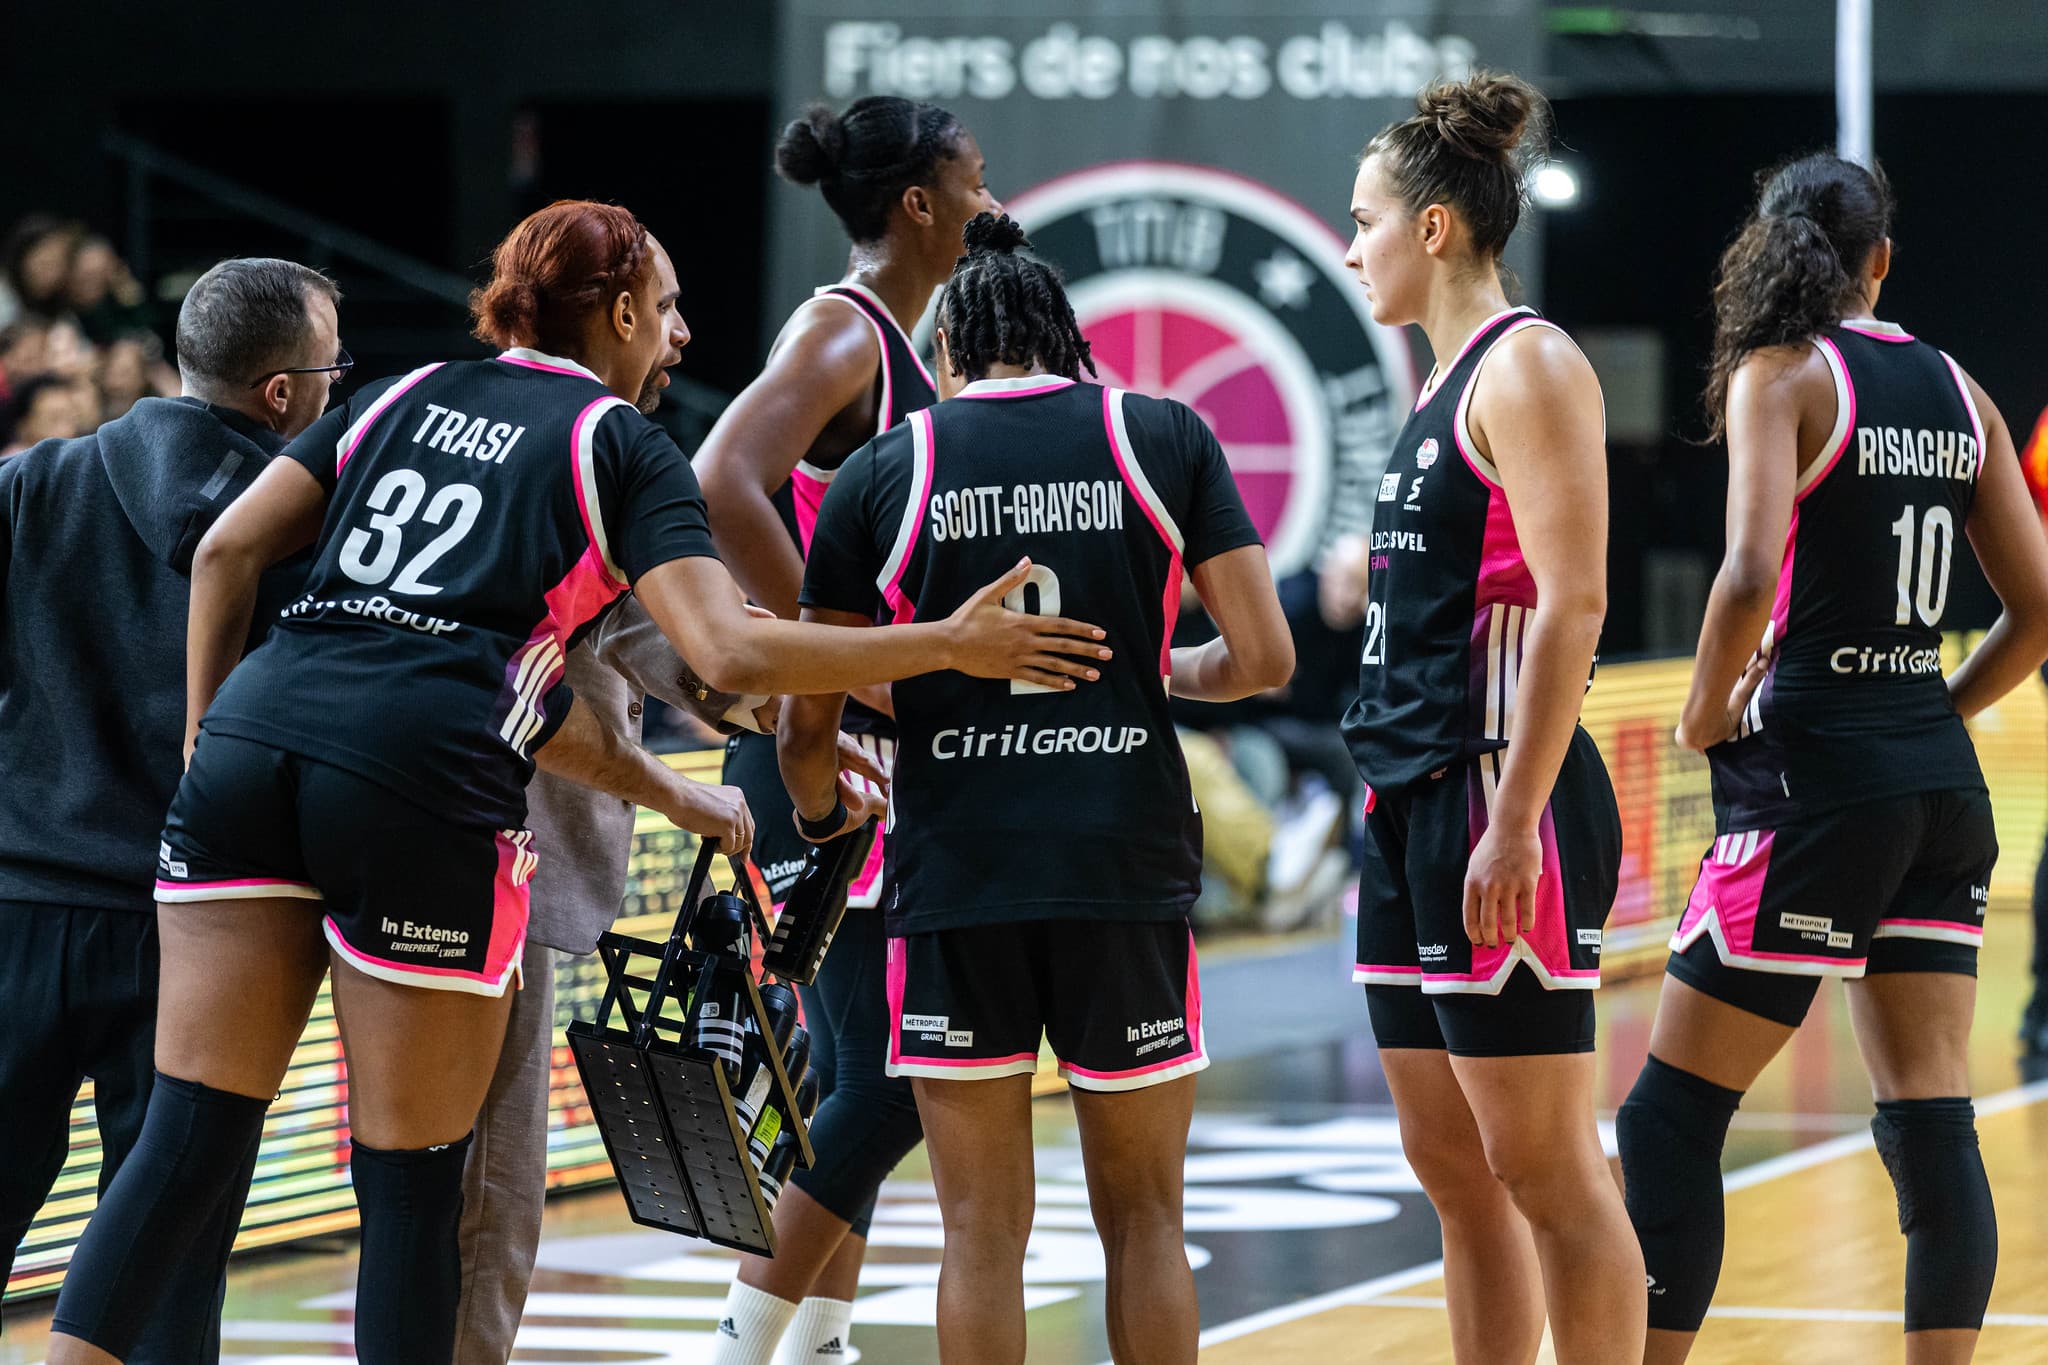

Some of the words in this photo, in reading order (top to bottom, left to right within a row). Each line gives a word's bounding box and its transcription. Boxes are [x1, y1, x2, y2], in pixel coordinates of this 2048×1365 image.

[825, 20, 1016, 99] Fiers
[1020, 20, 1124, 99] de
[1128, 35, 1272, 99] nos
[1277, 20, 1479, 99] clubs
[412, 403, 526, 464] TRASI
[1857, 426, 1978, 485] RISACHER
[930, 480, 1123, 542] SCOTT-GRAYSON
[338, 468, 483, 596] 32
[1892, 505, 1954, 628] 10
[931, 724, 1148, 760] CirilGROUP
[770, 859, 807, 880] Exten
[381, 916, 399, 936] In
[402, 920, 470, 944] Extenso
[390, 941, 440, 953] ENTREPRENEZ
[1801, 931, 1826, 942] GRAND
[1831, 935, 1849, 944] LYON
[920, 1032, 944, 1042] GRAND
[949, 1034, 969, 1043] LYON
[1127, 1026, 1140, 1042] In
[1141, 1017, 1184, 1039] Extenso
